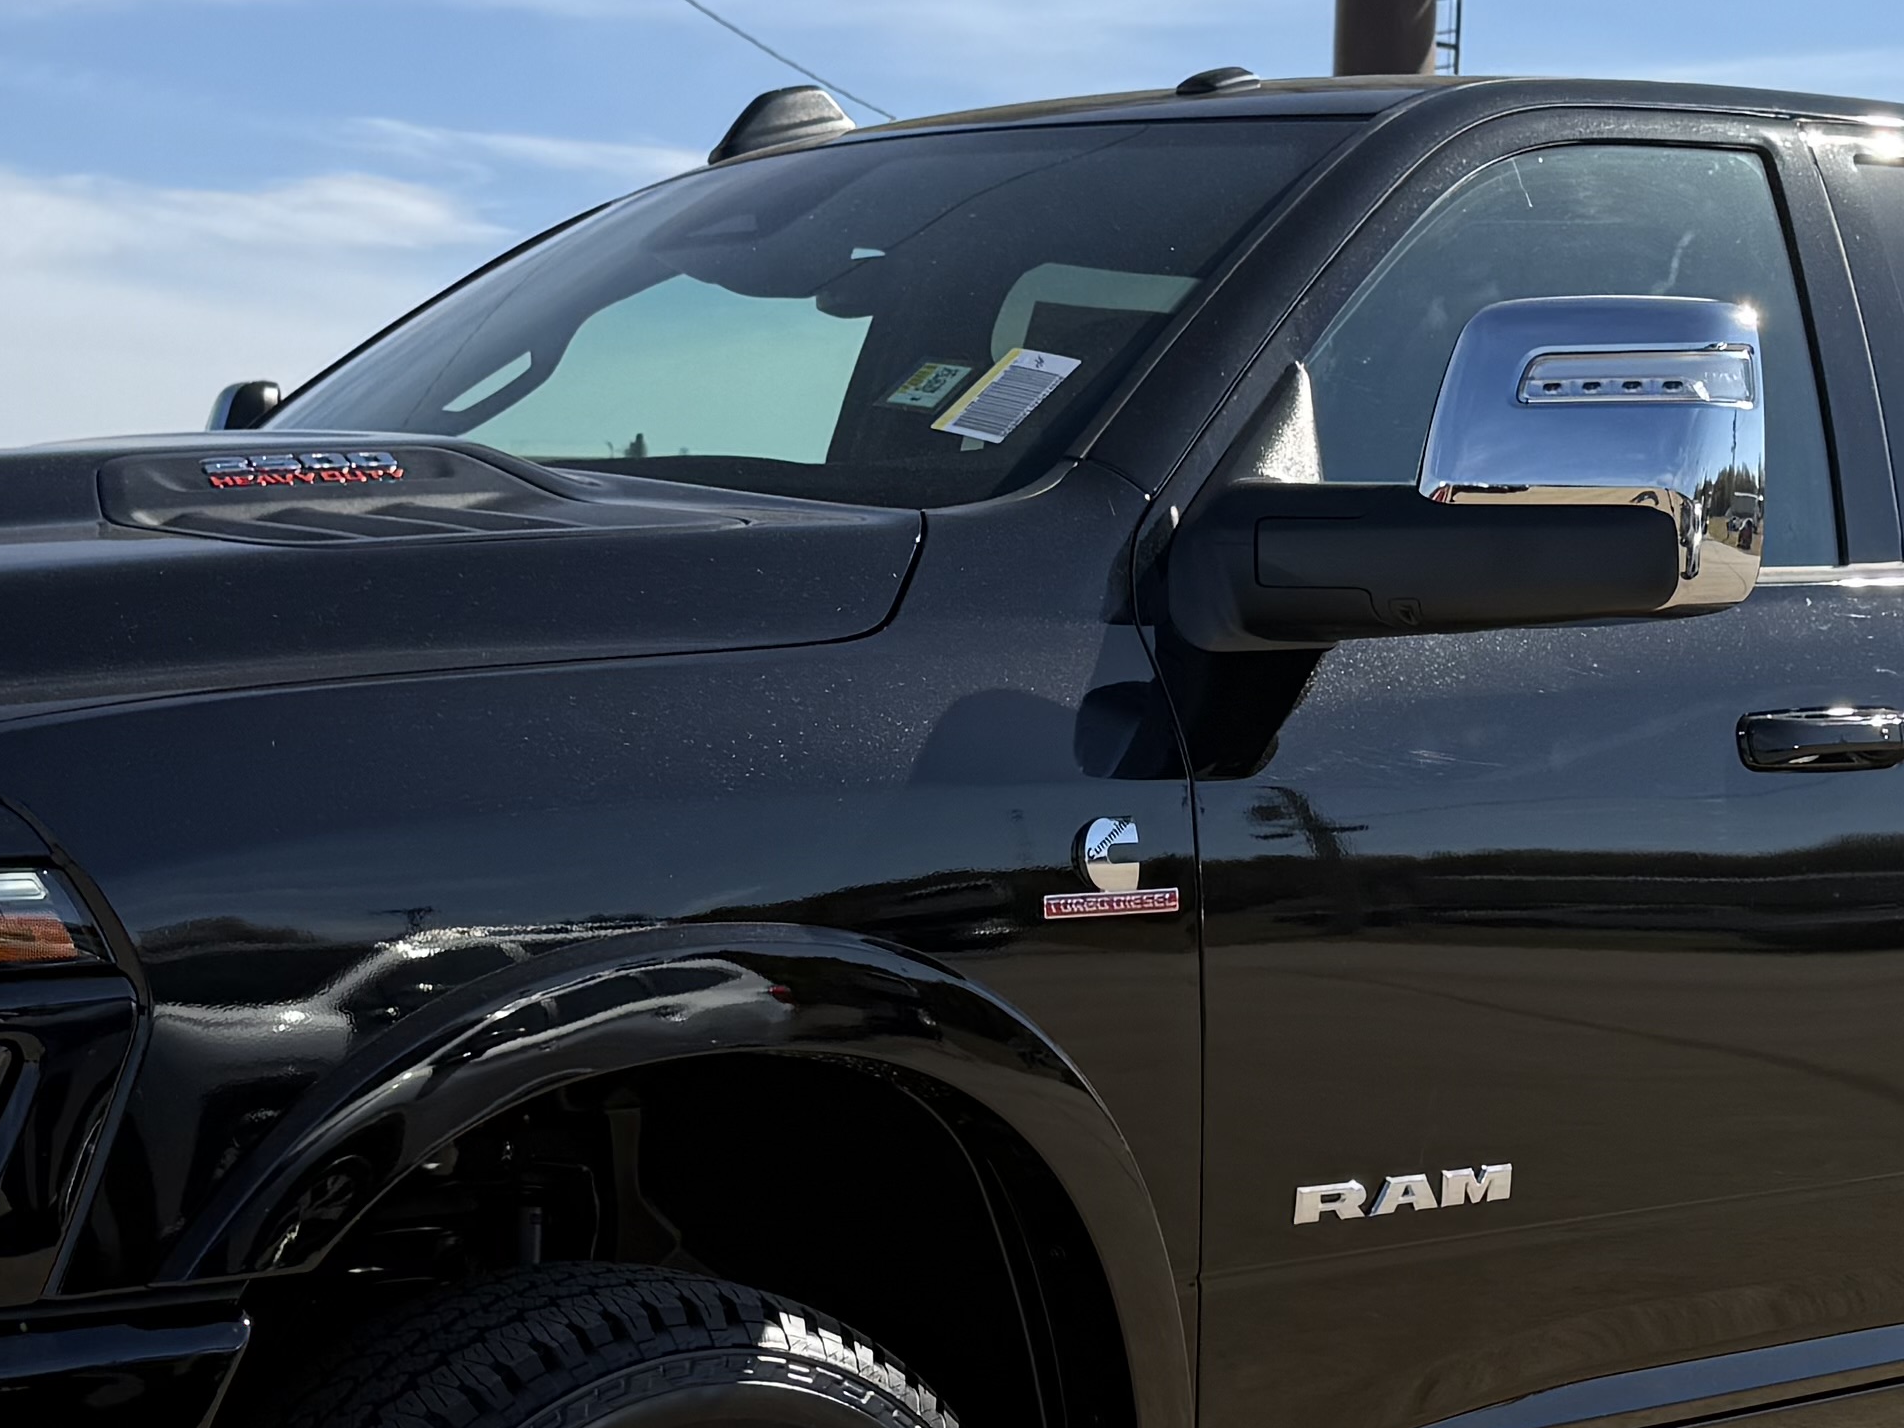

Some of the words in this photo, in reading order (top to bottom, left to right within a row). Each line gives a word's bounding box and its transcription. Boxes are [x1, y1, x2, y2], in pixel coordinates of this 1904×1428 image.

[209, 470, 315, 489] HEAVY
[1047, 897, 1110, 913] TURBO
[1113, 892, 1178, 910] DIESEL
[1293, 1163, 1513, 1225] RAM
